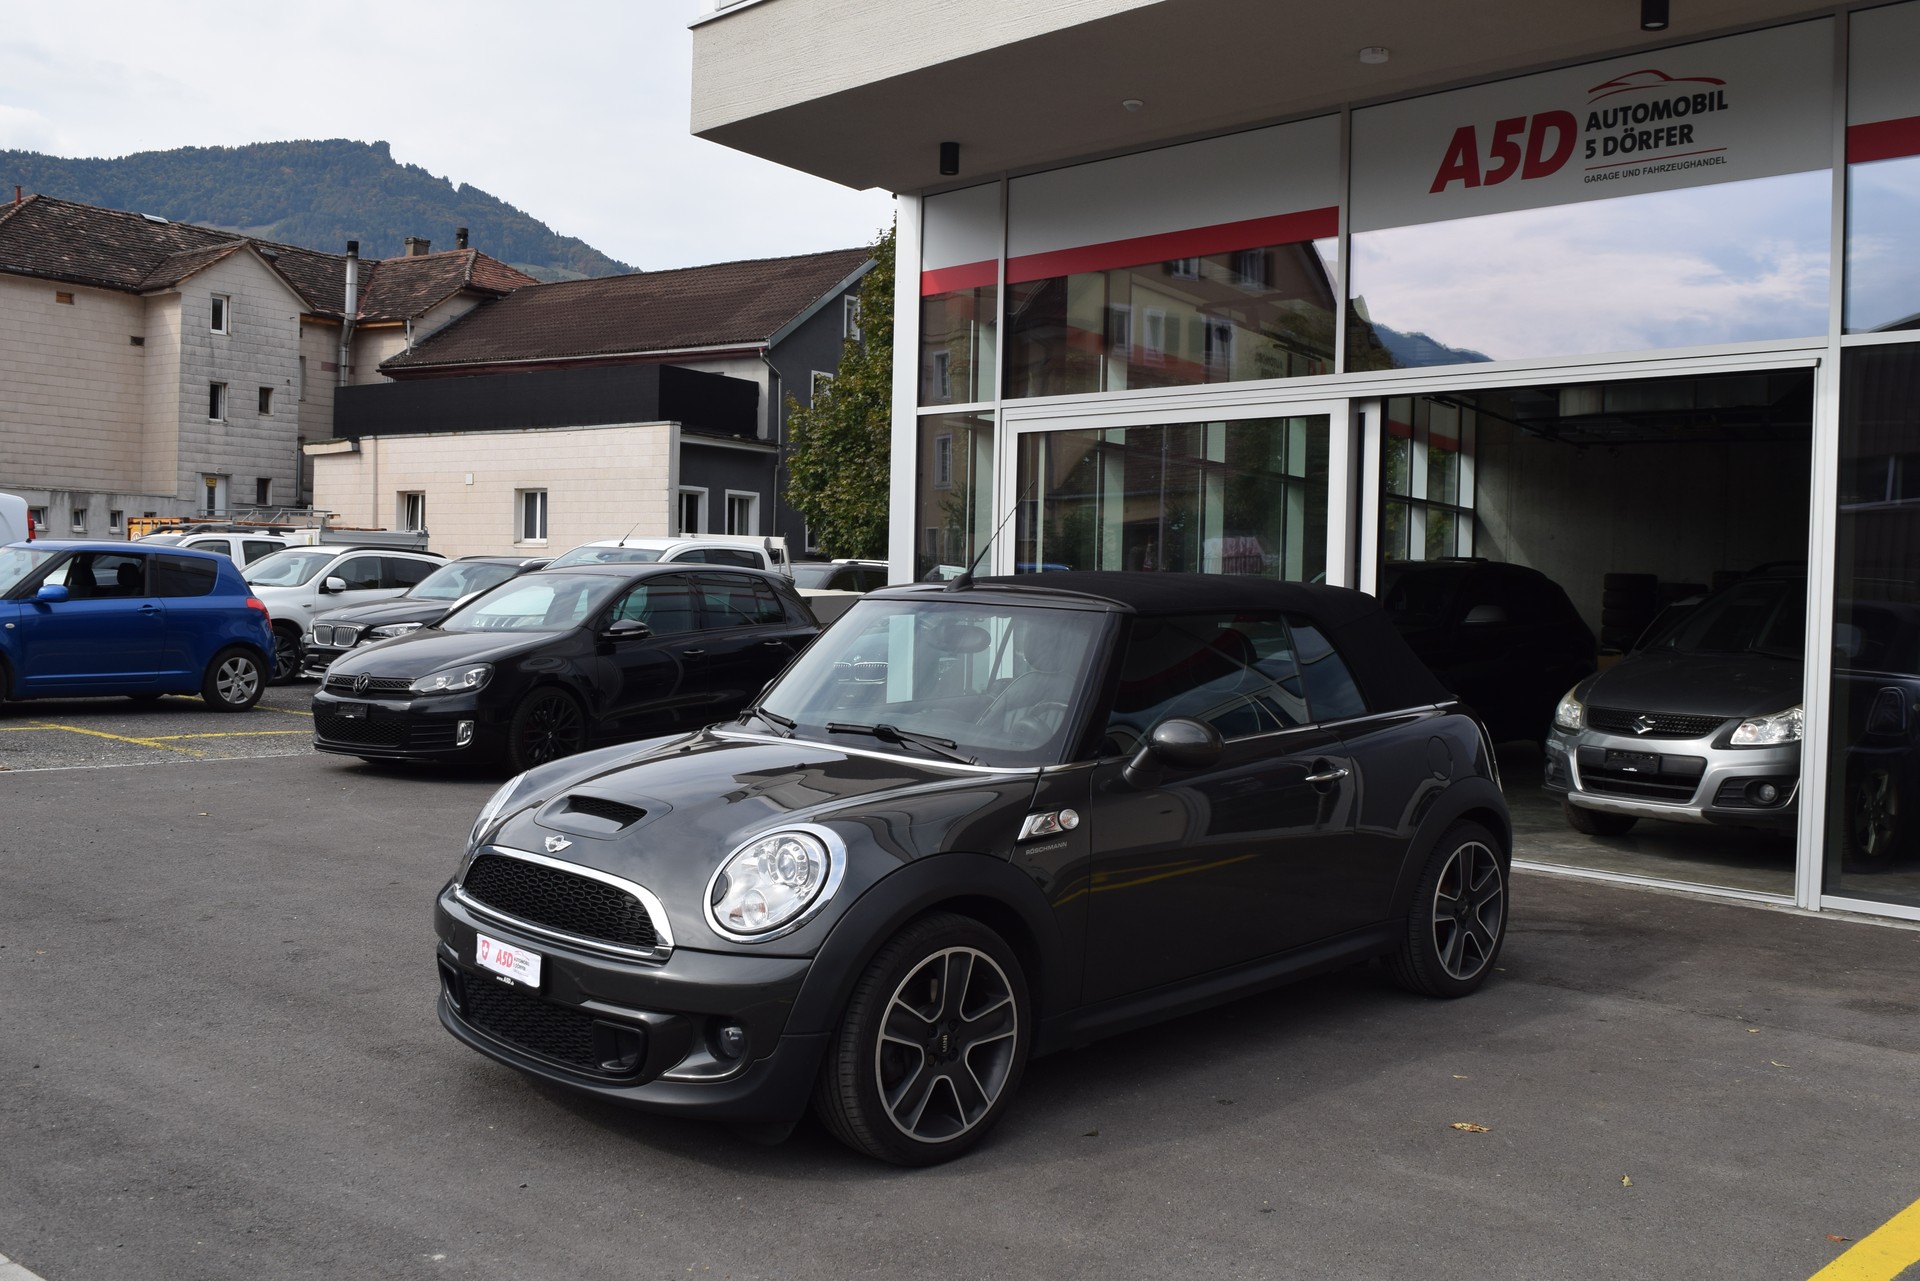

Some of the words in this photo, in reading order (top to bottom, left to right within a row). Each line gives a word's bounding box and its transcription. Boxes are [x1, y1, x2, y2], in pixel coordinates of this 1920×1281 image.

[1585, 90, 1728, 132] AUTOMOBIL
[1429, 110, 1578, 194] A5D
[1585, 139, 1597, 160] 5
[1603, 123, 1694, 157] DÖRFER
[1584, 171, 1620, 184] GARAGE
[1622, 168, 1641, 179] UND
[1643, 156, 1727, 175] FAHRZEUGHANDEL
[495, 949, 513, 968] A5D
